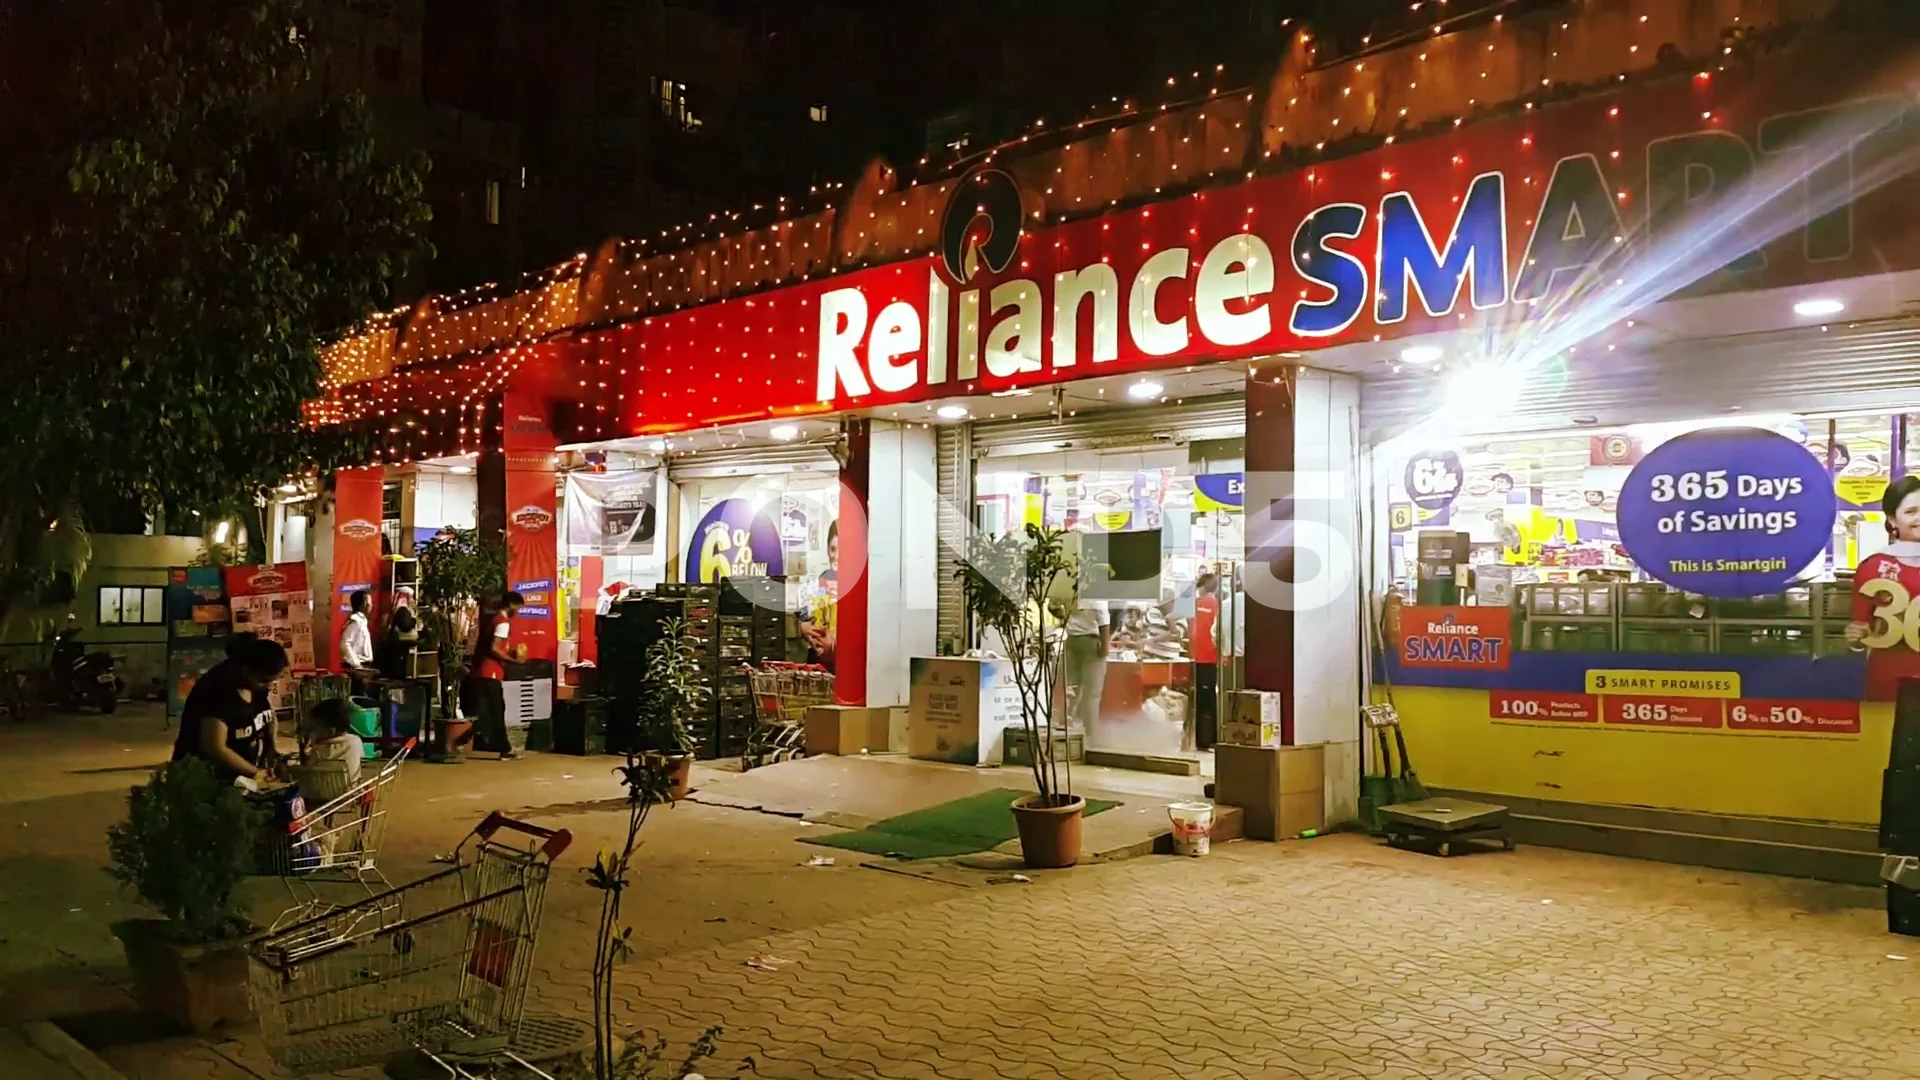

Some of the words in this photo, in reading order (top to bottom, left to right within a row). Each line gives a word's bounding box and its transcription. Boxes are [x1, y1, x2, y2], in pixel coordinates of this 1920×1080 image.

[816, 233, 1275, 402] Reliance
[1288, 94, 1910, 338] SMART
[1650, 470, 1729, 502] 365
[1737, 474, 1803, 501] Days
[1396, 511, 1405, 525] 6
[1657, 510, 1686, 533] of
[1690, 508, 1798, 535] Savings
[1669, 559, 1699, 573] This
[1702, 559, 1714, 572] is
[1716, 556, 1787, 573] Smartgiri
[1427, 621, 1479, 635] Reliance
[1404, 635, 1504, 664] SMART
[1595, 675, 1607, 689] 3
[1611, 678, 1656, 689] SMART
[1661, 679, 1731, 691] PROMISES
[1622, 703, 1668, 721] 365
[1670, 705, 1688, 713] Days
